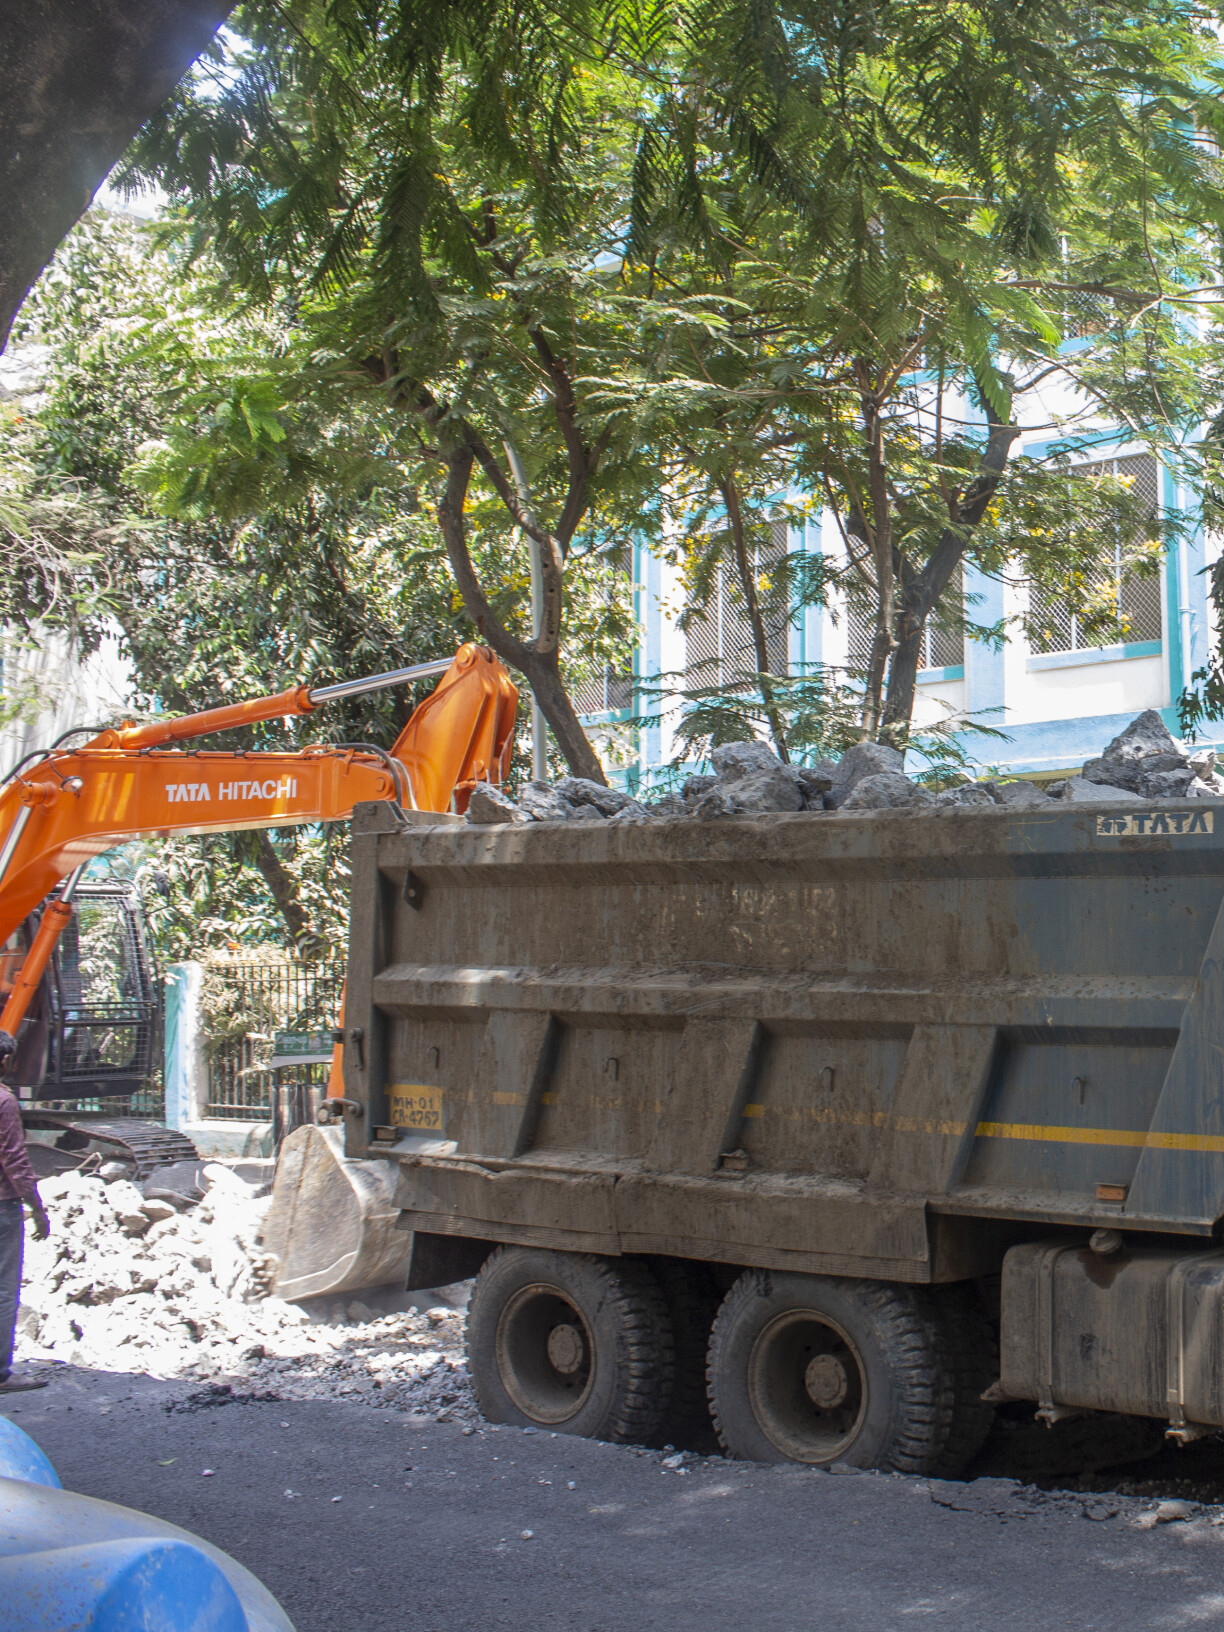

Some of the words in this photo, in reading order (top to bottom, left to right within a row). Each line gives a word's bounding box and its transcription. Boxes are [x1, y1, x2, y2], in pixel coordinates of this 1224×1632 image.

[165, 783, 211, 803] TATA
[218, 778, 297, 801] HITACHI
[1131, 812, 1209, 834] TATA
